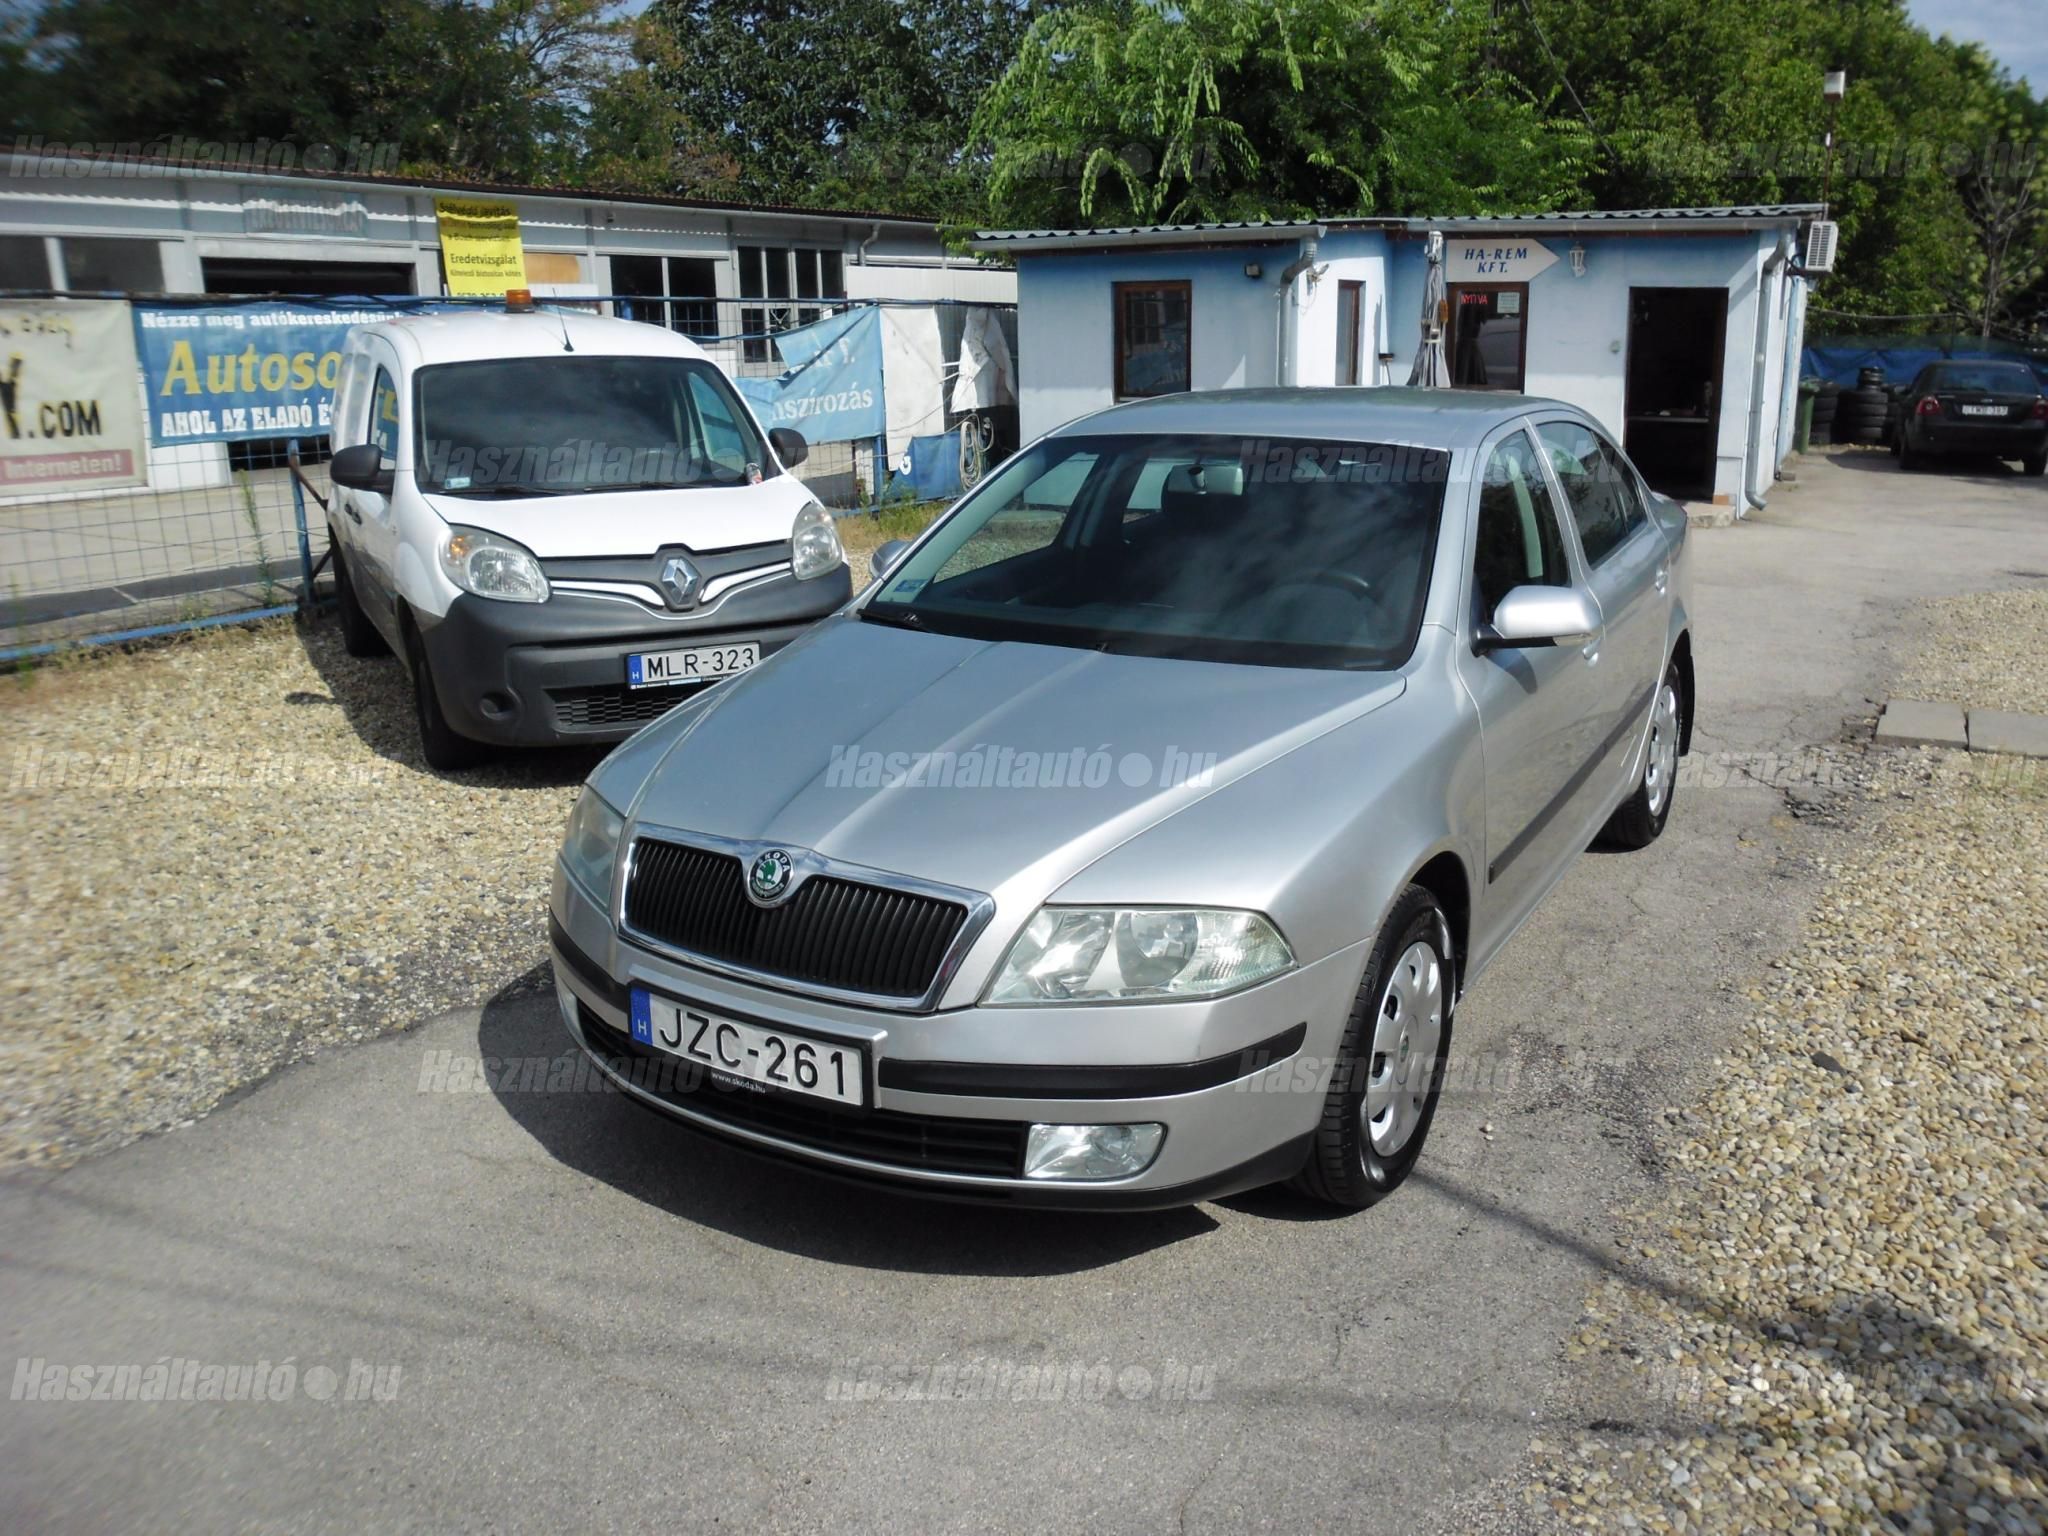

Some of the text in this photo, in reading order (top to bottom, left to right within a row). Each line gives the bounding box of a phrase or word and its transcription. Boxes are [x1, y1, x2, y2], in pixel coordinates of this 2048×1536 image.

[450, 253, 517, 267] Eredetvizsgálat
[1464, 247, 1528, 260] HA-REM
[1477, 261, 1508, 273] KFT.
[140, 312, 199, 328] Nézze
[205, 313, 244, 329] meg
[161, 409, 217, 437] AHOL
[222, 407, 247, 432] AZ
[252, 398, 312, 430] ELADÓ
[647, 648, 754, 679] MLR-323
[637, 1018, 648, 1036] H
[659, 1008, 845, 1096] JZC-261
